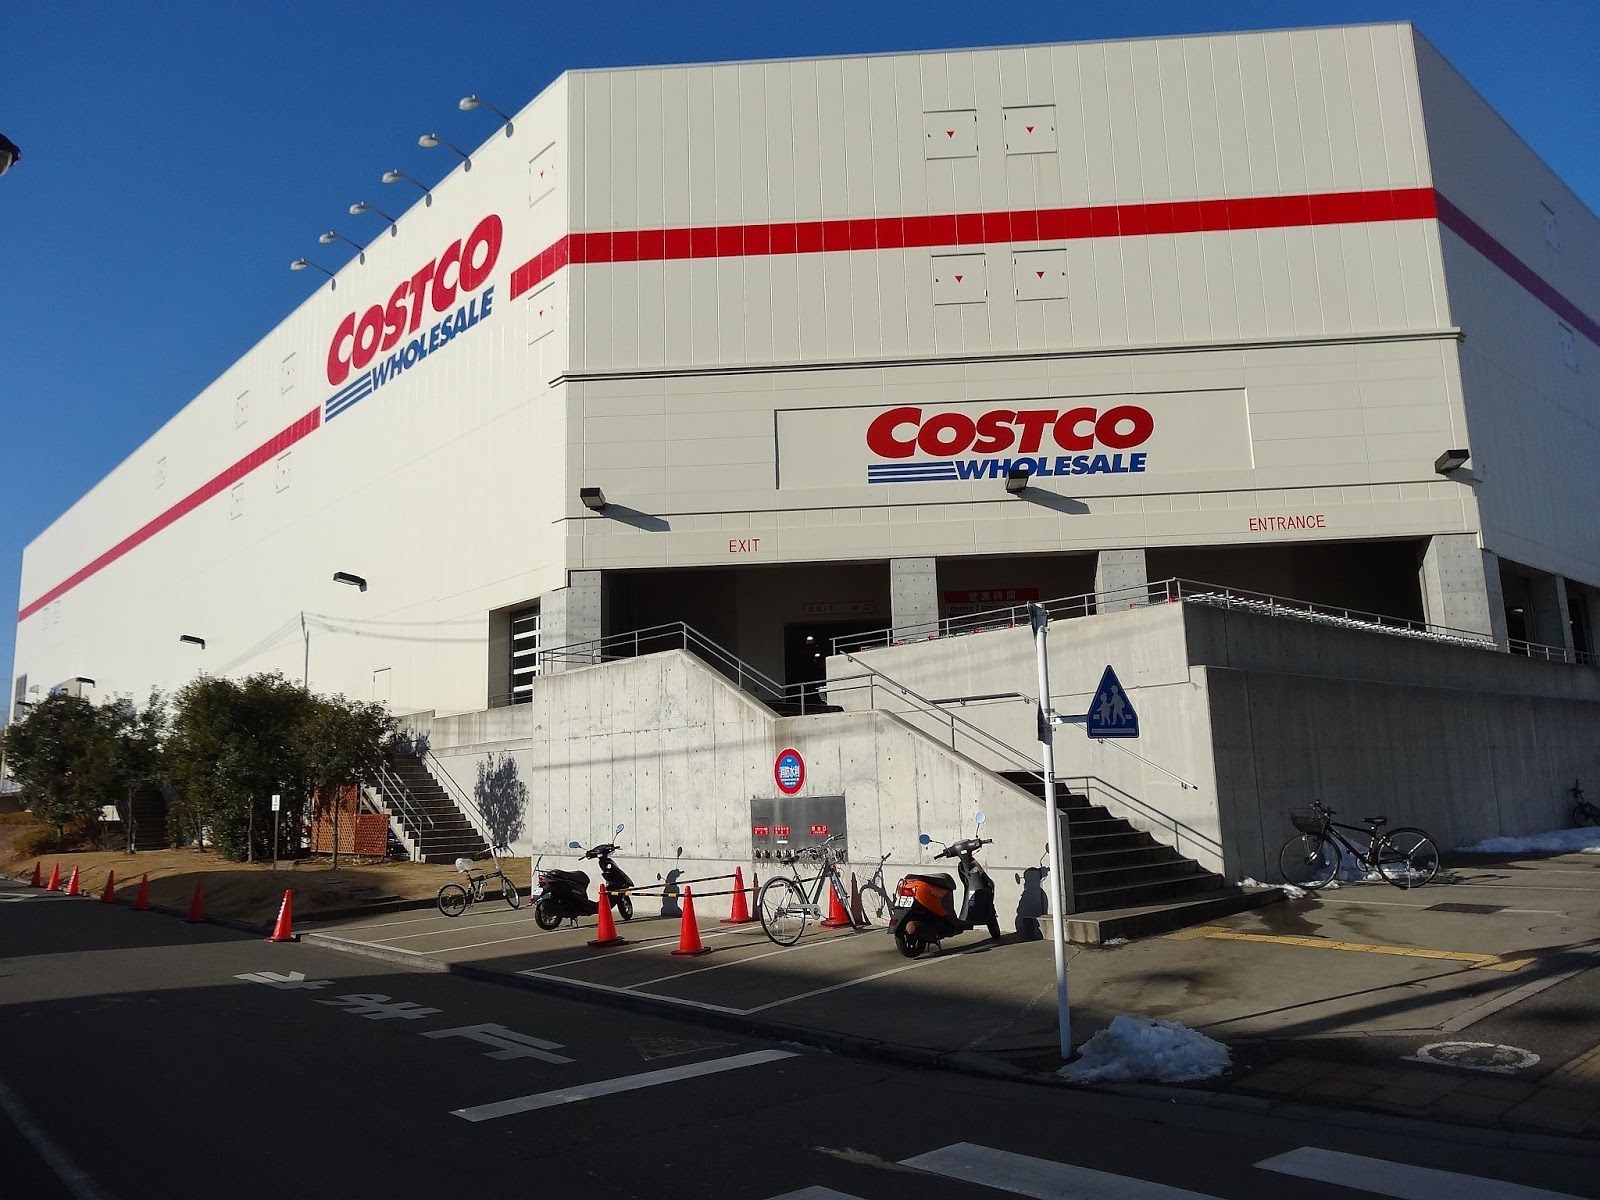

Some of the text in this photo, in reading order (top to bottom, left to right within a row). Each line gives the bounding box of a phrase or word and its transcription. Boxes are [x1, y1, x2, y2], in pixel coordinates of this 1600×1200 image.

[327, 214, 503, 386] COSTCO
[372, 285, 495, 391] WHOLESALE
[866, 405, 1154, 459] COSTCO
[954, 453, 1147, 480] WHOLESALE
[1249, 514, 1326, 531] ENTRANCE
[729, 538, 760, 553] EXIT
